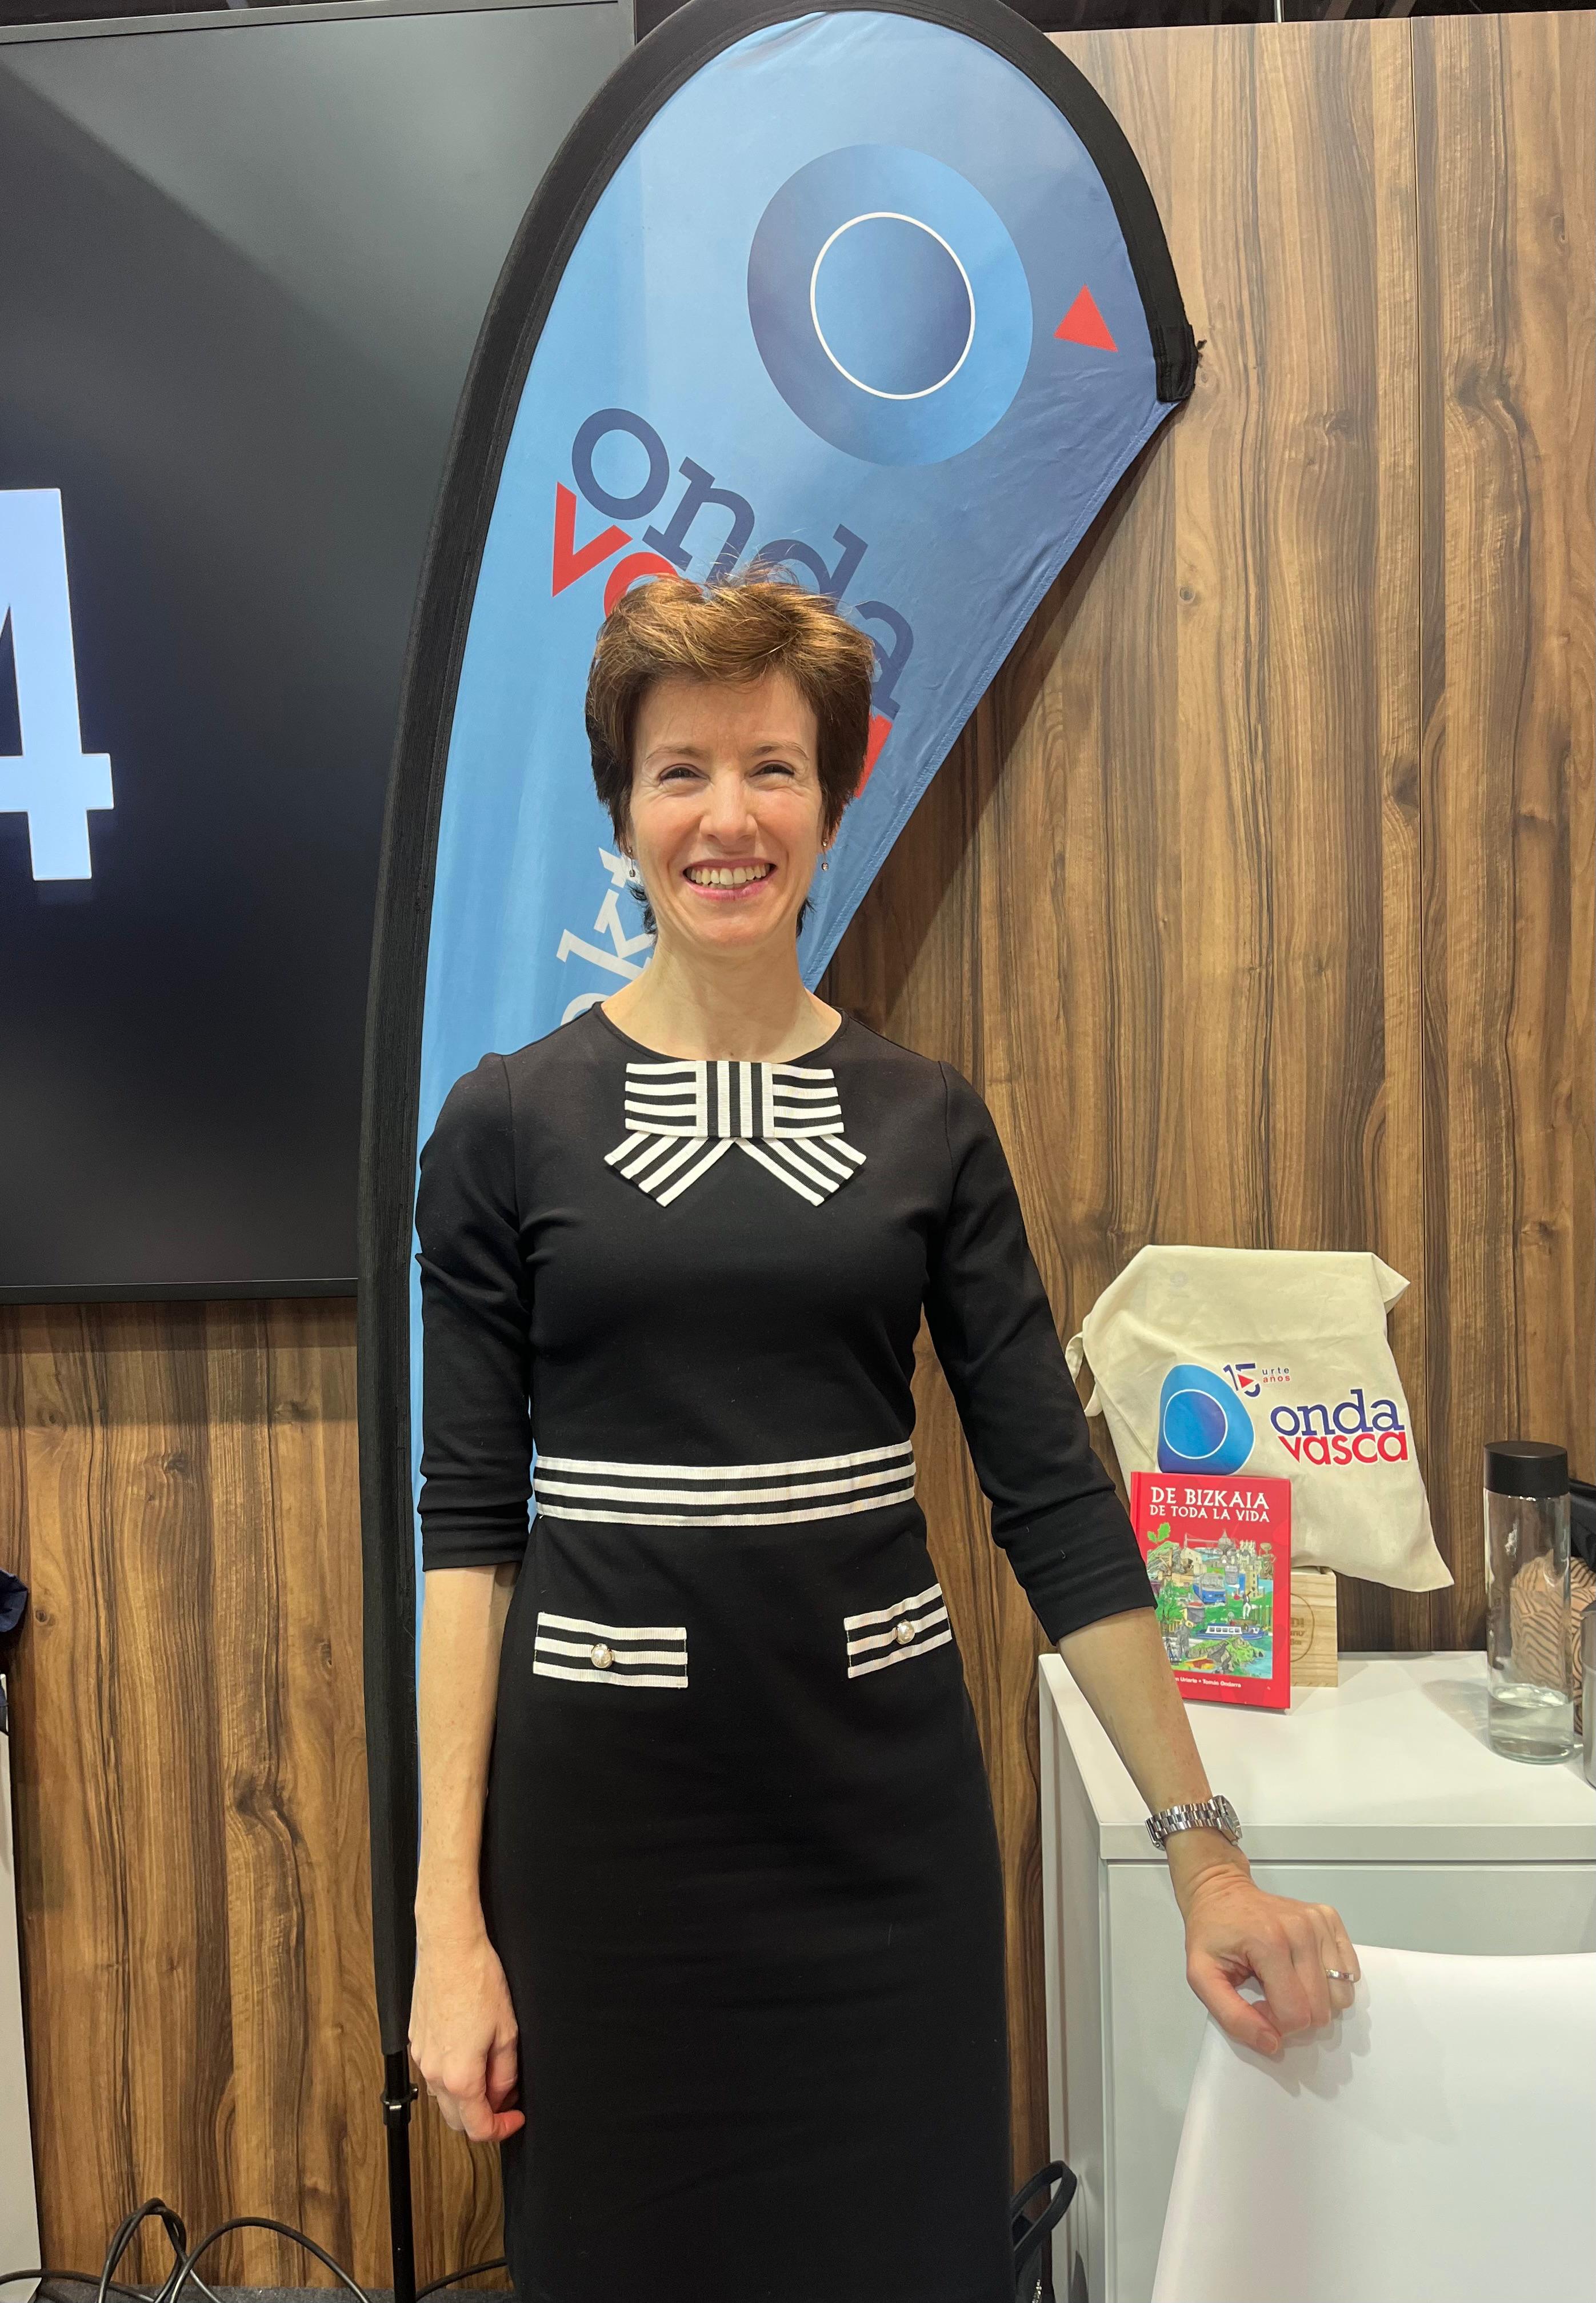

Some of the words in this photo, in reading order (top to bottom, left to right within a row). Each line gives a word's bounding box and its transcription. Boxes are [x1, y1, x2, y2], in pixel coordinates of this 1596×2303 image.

[1223, 1363, 1261, 1397] 15
[1262, 1367, 1289, 1375] urte
[1270, 1388, 1405, 1436] onda
[1278, 1431, 1408, 1465] vasca
[1151, 1486, 1177, 1504] DE
[1184, 1488, 1270, 1510] BIZKAIA
[1150, 1504, 1166, 1516] DE
[1171, 1506, 1208, 1519] TODA
[1213, 1508, 1231, 1520] LA
[1236, 1509, 1270, 1523] VIDA
